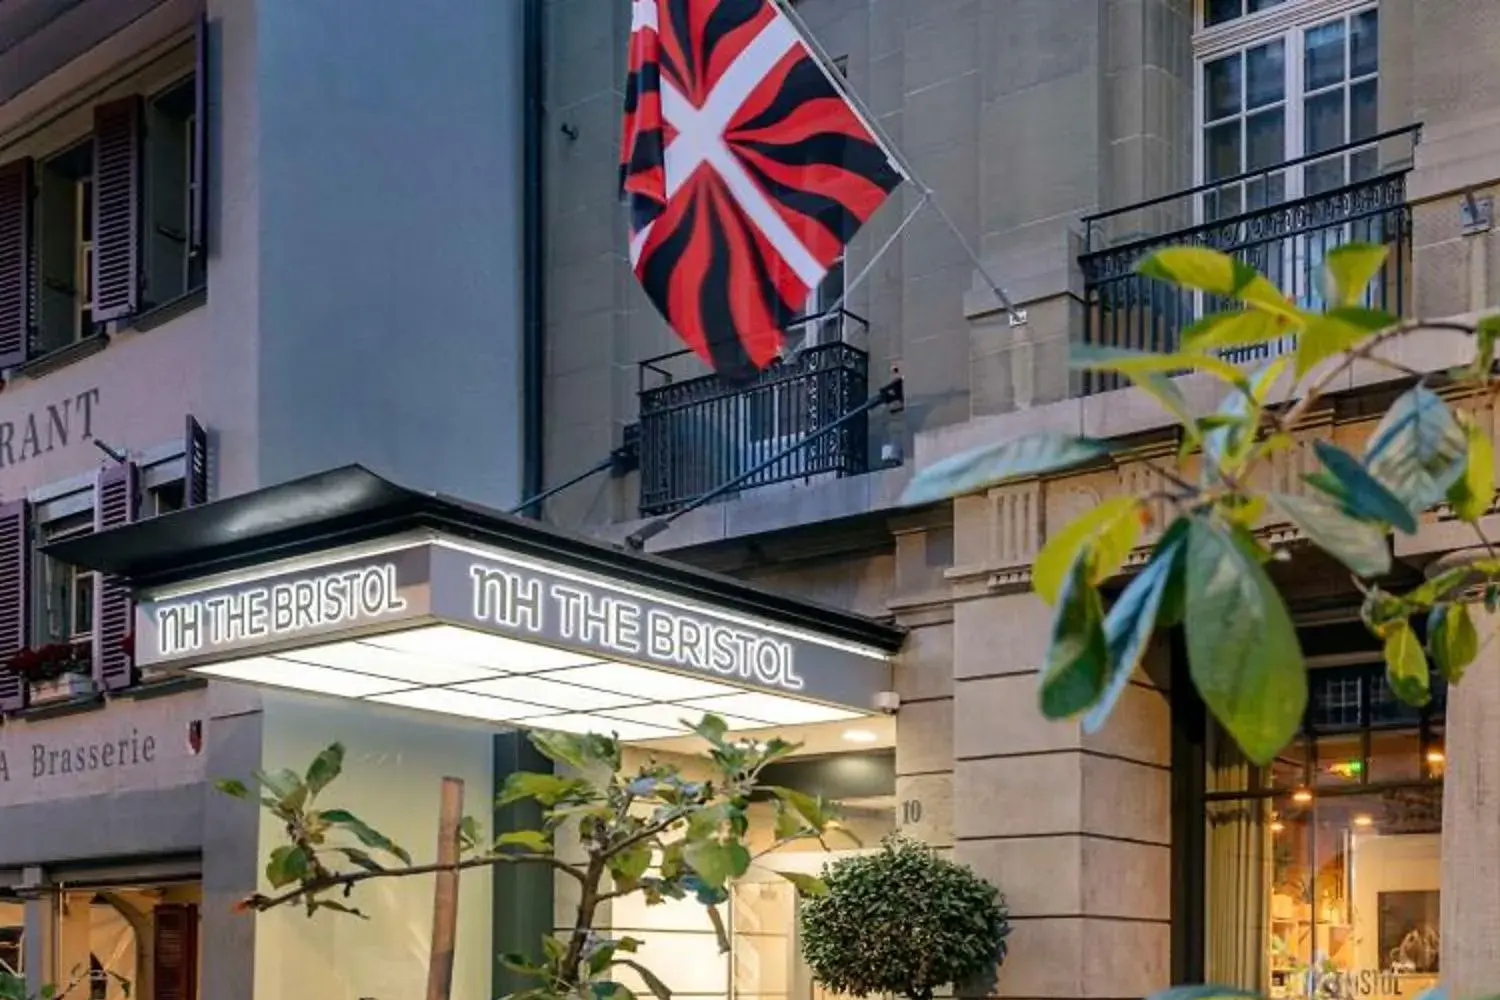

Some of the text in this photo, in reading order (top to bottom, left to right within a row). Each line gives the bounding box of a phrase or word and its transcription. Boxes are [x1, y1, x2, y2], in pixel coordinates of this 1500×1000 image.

[0, 387, 99, 468] RANT
[208, 587, 268, 643] THE
[271, 563, 406, 632] BRISTOL
[551, 584, 642, 654] THE
[647, 608, 804, 690] BRISTOL
[32, 728, 156, 778] Brasserie
[902, 799, 922, 825] 10
